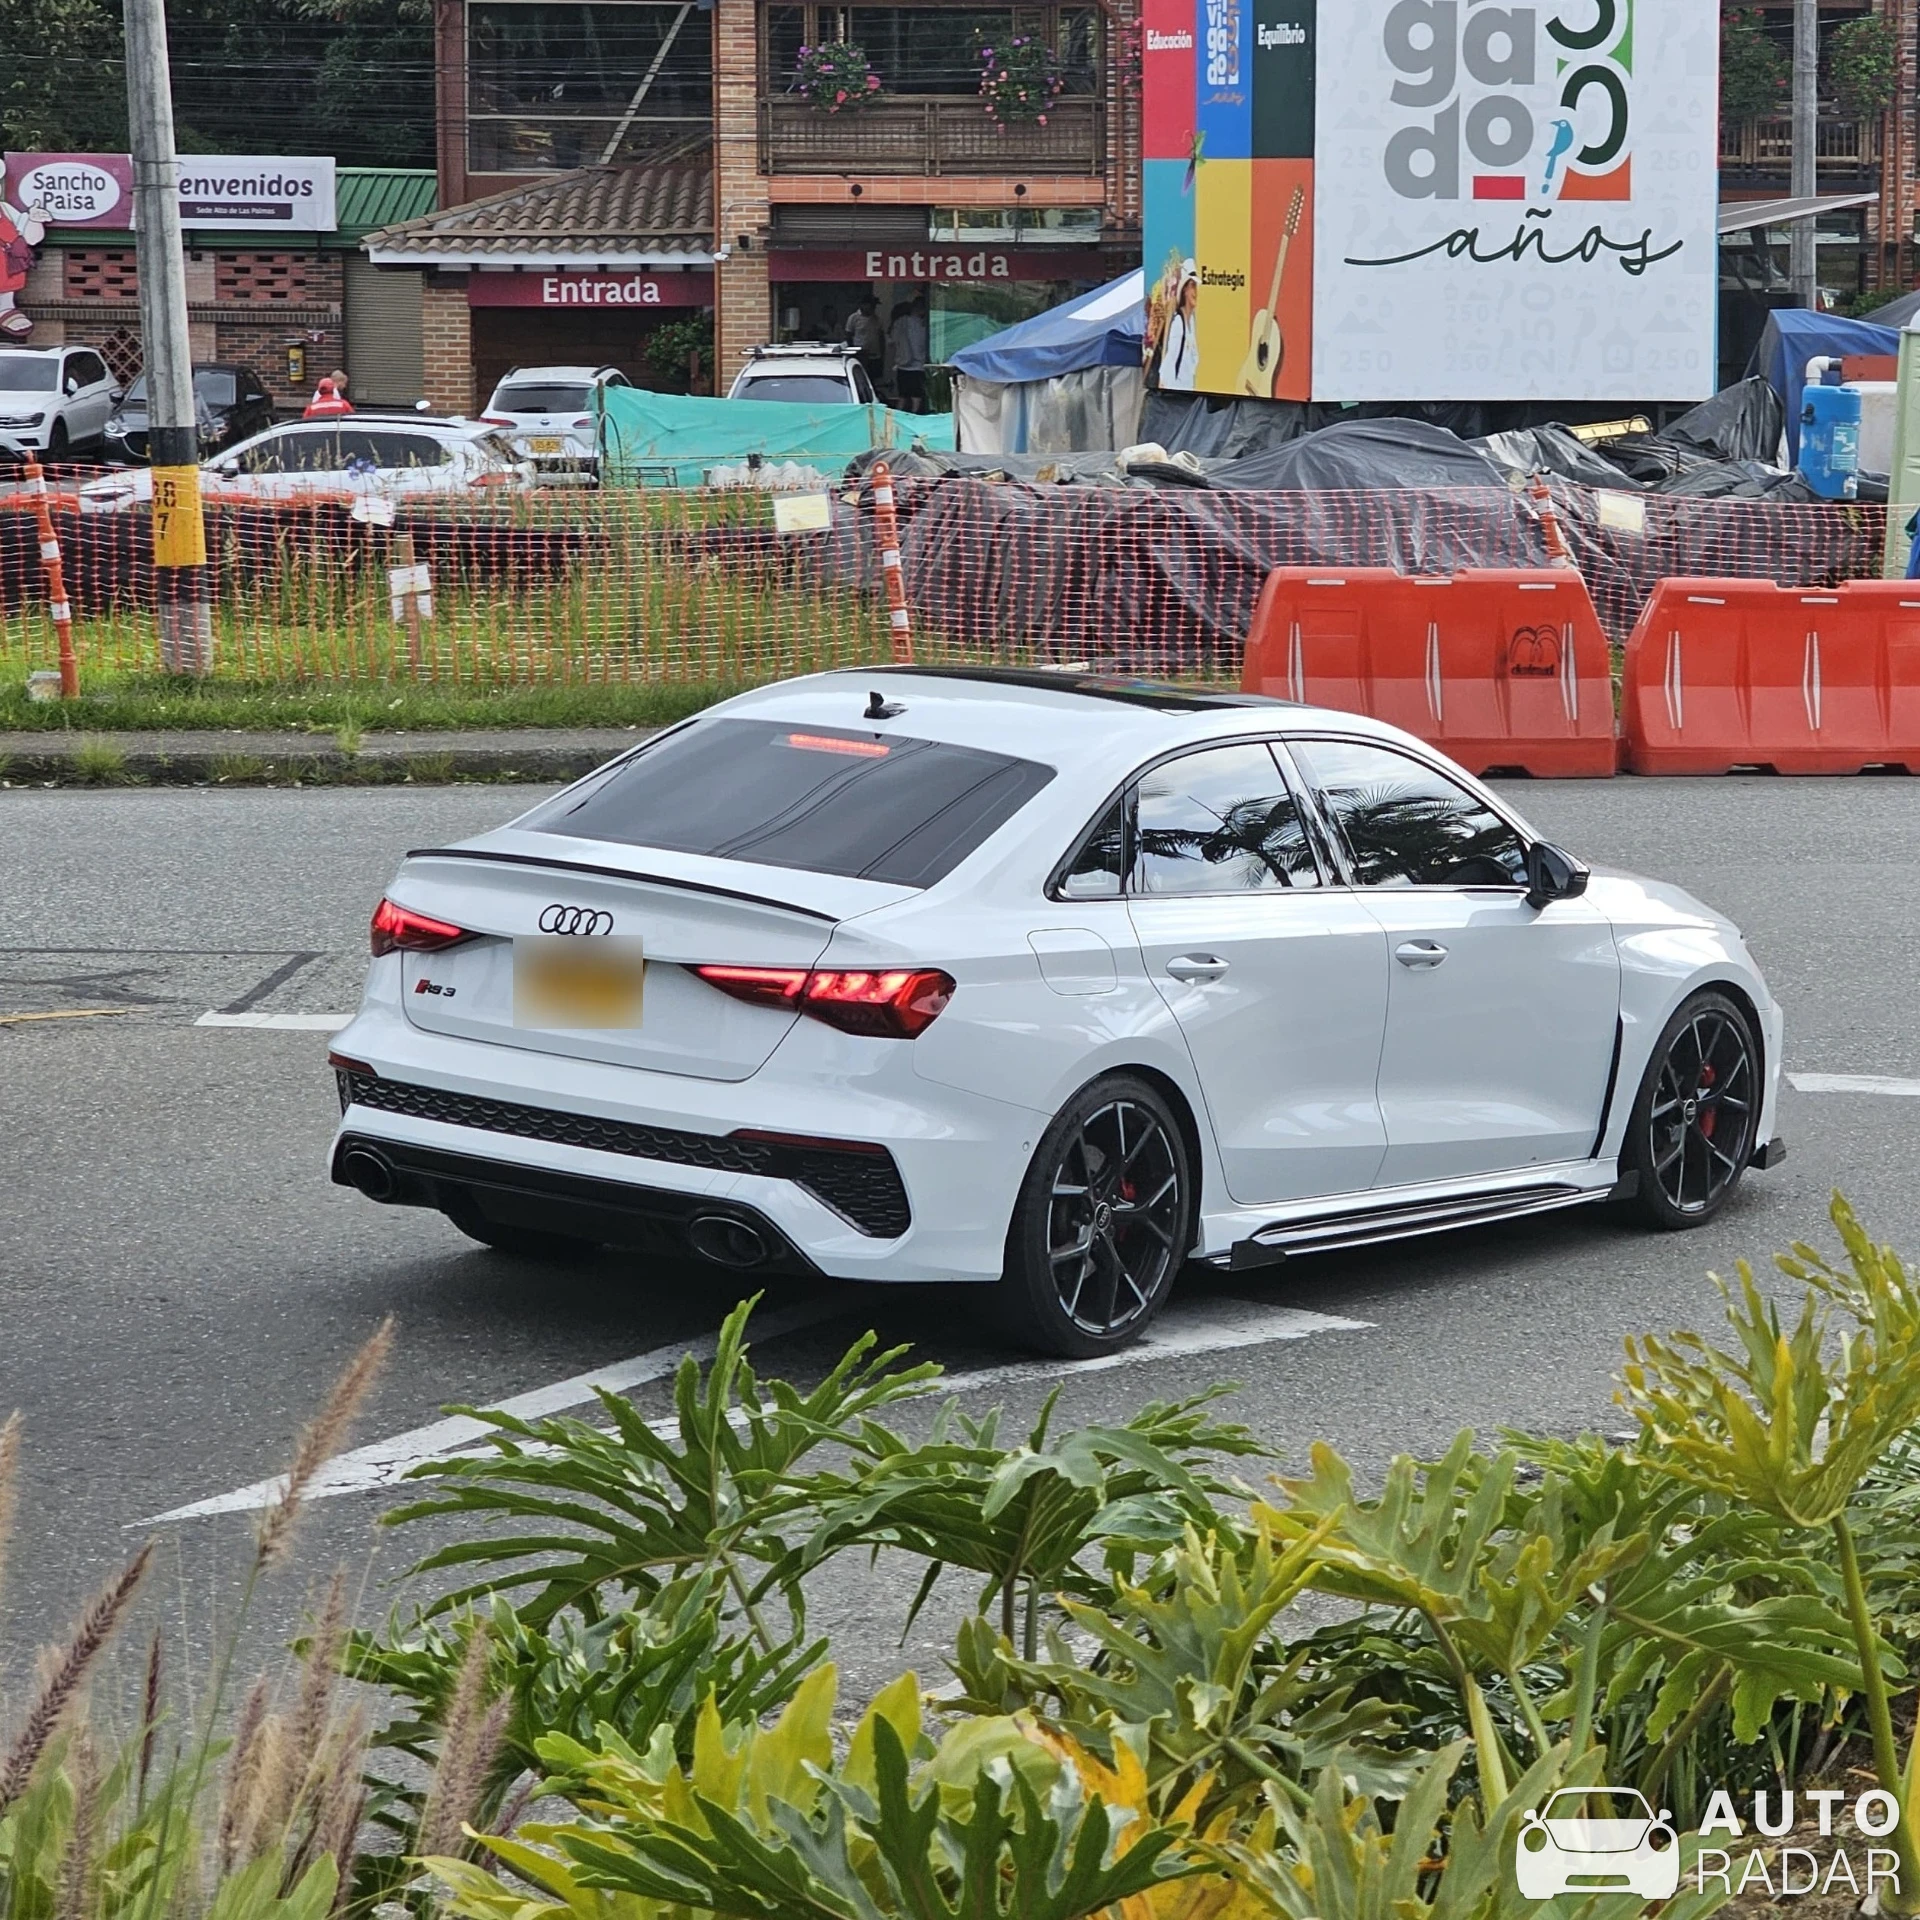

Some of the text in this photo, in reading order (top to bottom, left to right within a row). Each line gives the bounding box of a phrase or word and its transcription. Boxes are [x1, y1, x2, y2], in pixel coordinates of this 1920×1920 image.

[1147, 29, 1192, 50] Educación
[1257, 23, 1305, 50] Equilibrio
[1649, 150, 1700, 172] 250
[33, 172, 106, 192] Sancho
[178, 173, 314, 197] envenidos
[43, 192, 96, 210] Paisa
[1344, 208, 1684, 276] años
[866, 252, 1009, 277] Entrada
[543, 276, 660, 303] Entrada
[1201, 266, 1245, 291] Estrategia
[1339, 349, 1393, 372] 250
[1647, 350, 1700, 371] 250
